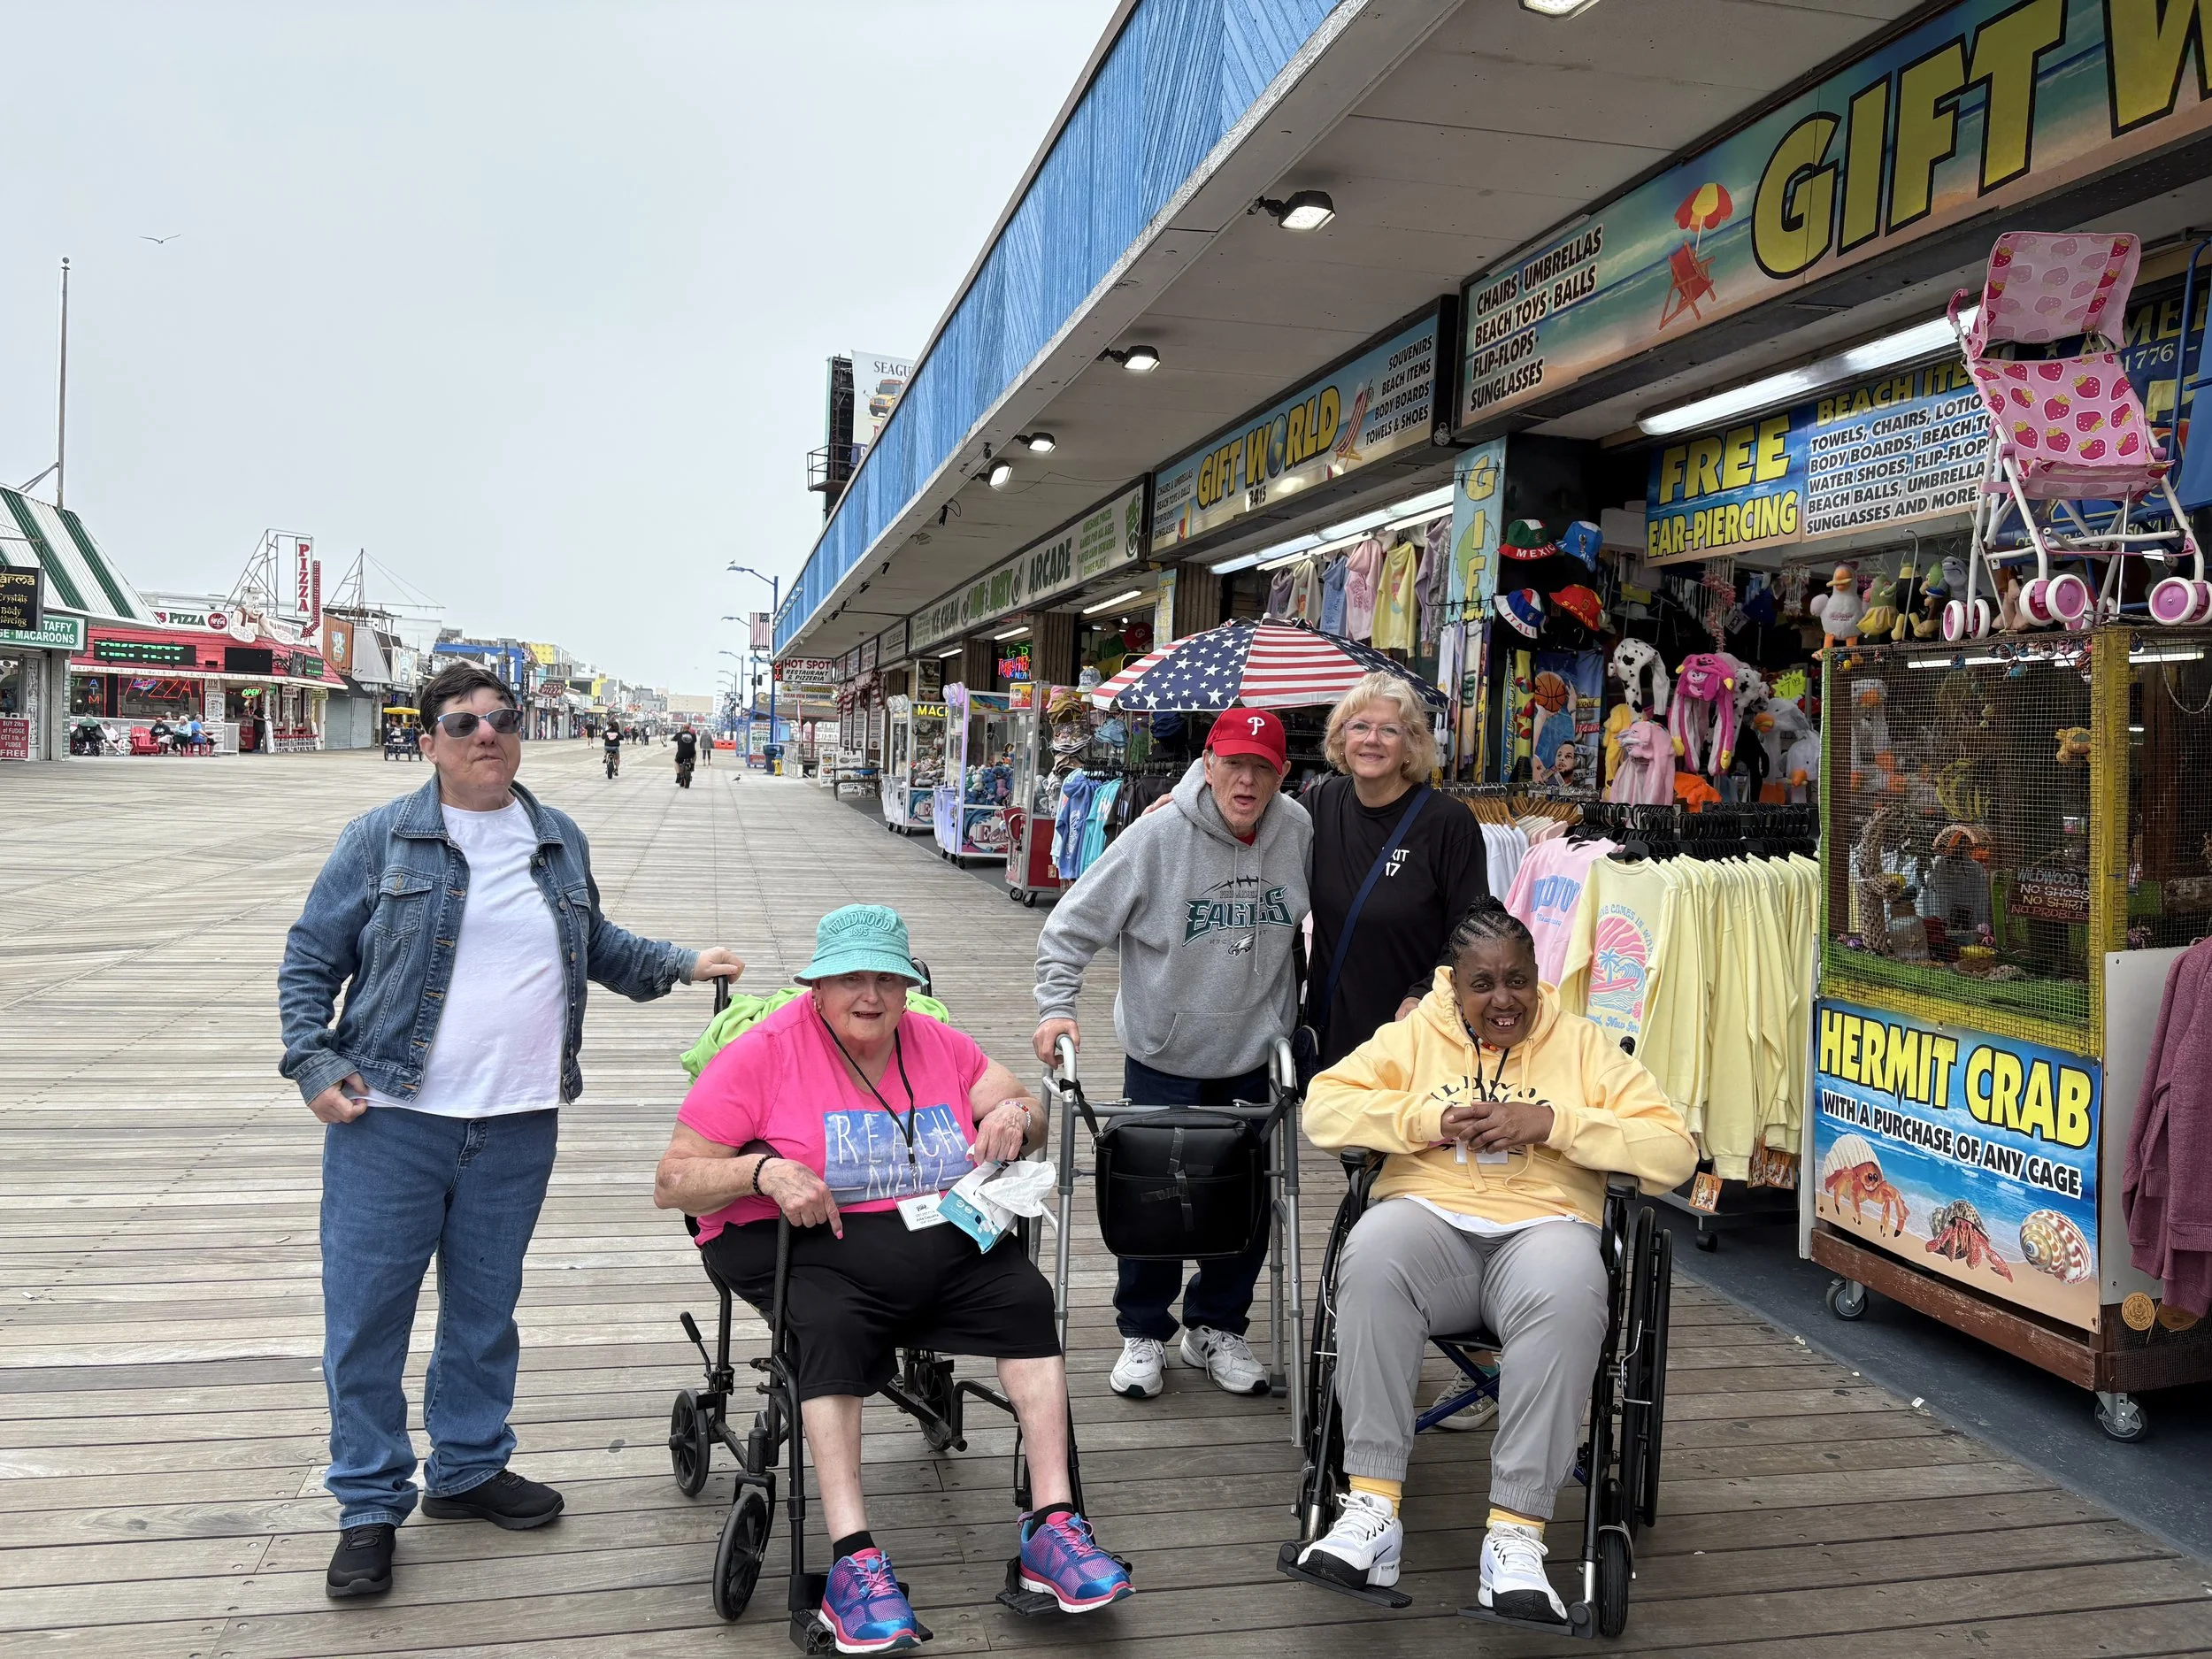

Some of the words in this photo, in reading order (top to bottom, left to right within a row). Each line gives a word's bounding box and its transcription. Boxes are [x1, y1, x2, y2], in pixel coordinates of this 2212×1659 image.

[1751, 0, 2068, 280] GIFT
[1478, 273, 1518, 316] CHAIRS
[1524, 227, 1602, 291] UMBRELLAS
[1475, 314, 1511, 349] BEACH
[1516, 291, 1548, 328] TOYS
[1553, 265, 1595, 309] BALLS
[873, 360, 914, 378] SEAGU
[1388, 334, 1432, 372] SOUVENIRS
[1473, 330, 1534, 380] FLIP-FLOPS
[2124, 342, 2174, 373] 1776
[1382, 372, 1405, 396] BEACH
[1407, 357, 1431, 383] ITEMS
[1471, 358, 1543, 411] SUNGLASSES
[1816, 373, 1913, 426] BEACH
[1923, 359, 1974, 396] ITE
[1375, 396, 1394, 421] BODY
[1395, 380, 1430, 410] BOARDS
[1366, 420, 1392, 445] TOWELS
[1394, 418, 1399, 432] &
[1402, 403, 1428, 429] SHOES
[1812, 425, 1868, 452] TOWELS,
[1872, 409, 1931, 436] CHAIRS,
[1936, 394, 1985, 420] LOTIO
[1197, 435, 1243, 511] GIFT
[1245, 385, 1341, 489] WORLD
[1658, 413, 1792, 506] FREE
[1810, 451, 1847, 473] BODY
[1851, 435, 1916, 464] BOARDS,
[1809, 471, 1854, 493] WATER
[1857, 457, 1911, 482] SHOES,
[1809, 492, 1850, 514] BEACH
[1854, 481, 1902, 504] BALLS,
[1908, 457, 1987, 493] UMBRELLA
[1156, 498, 1169, 511] BEACH
[1248, 485, 1266, 506] 3415
[1647, 489, 1798, 558] EAR-PIERCING
[1807, 505, 1890, 534] SUNGLASSES
[1894, 497, 1927, 518] AND
[1027, 536, 1072, 595] ARCADE
[1516, 541, 1556, 558] MEXIC
[298, 543, 310, 612] PIZZA
[43, 620, 73, 633] TAFFY
[169, 612, 206, 626] PIZZA
[1561, 600, 1594, 627] SPAIN
[15, 630, 75, 644] MACAROONS
[784, 659, 803, 669] HOT
[806, 660, 831, 670] SPOT
[88, 679, 100, 704] ATM
[1386, 862, 1401, 877] 17
[2011, 904, 2029, 914] NO
[2020, 883, 2040, 895] NO
[2044, 886, 2090, 901] SHOES
[2024, 895, 2042, 905] NO
[2047, 896, 2087, 910] SHIRT
[829, 910, 891, 935] WILDWOOD
[849, 926, 869, 937] 1895
[1610, 903, 1636, 920] COMES
[1635, 917, 1644, 928] IN
[1818, 1007, 1959, 1110] HERMIT
[1965, 1044, 2094, 1148] CRAB
[836, 1108, 964, 1164] REACH
[1823, 1092, 1858, 1123] WITH
[1860, 1106, 1872, 1127] A
[1874, 1109, 1952, 1155] PURCHASE
[1957, 1133, 1980, 1164] OF
[1984, 1146, 2025, 1179] ANY
[2028, 1158, 2081, 1195] CAGE
